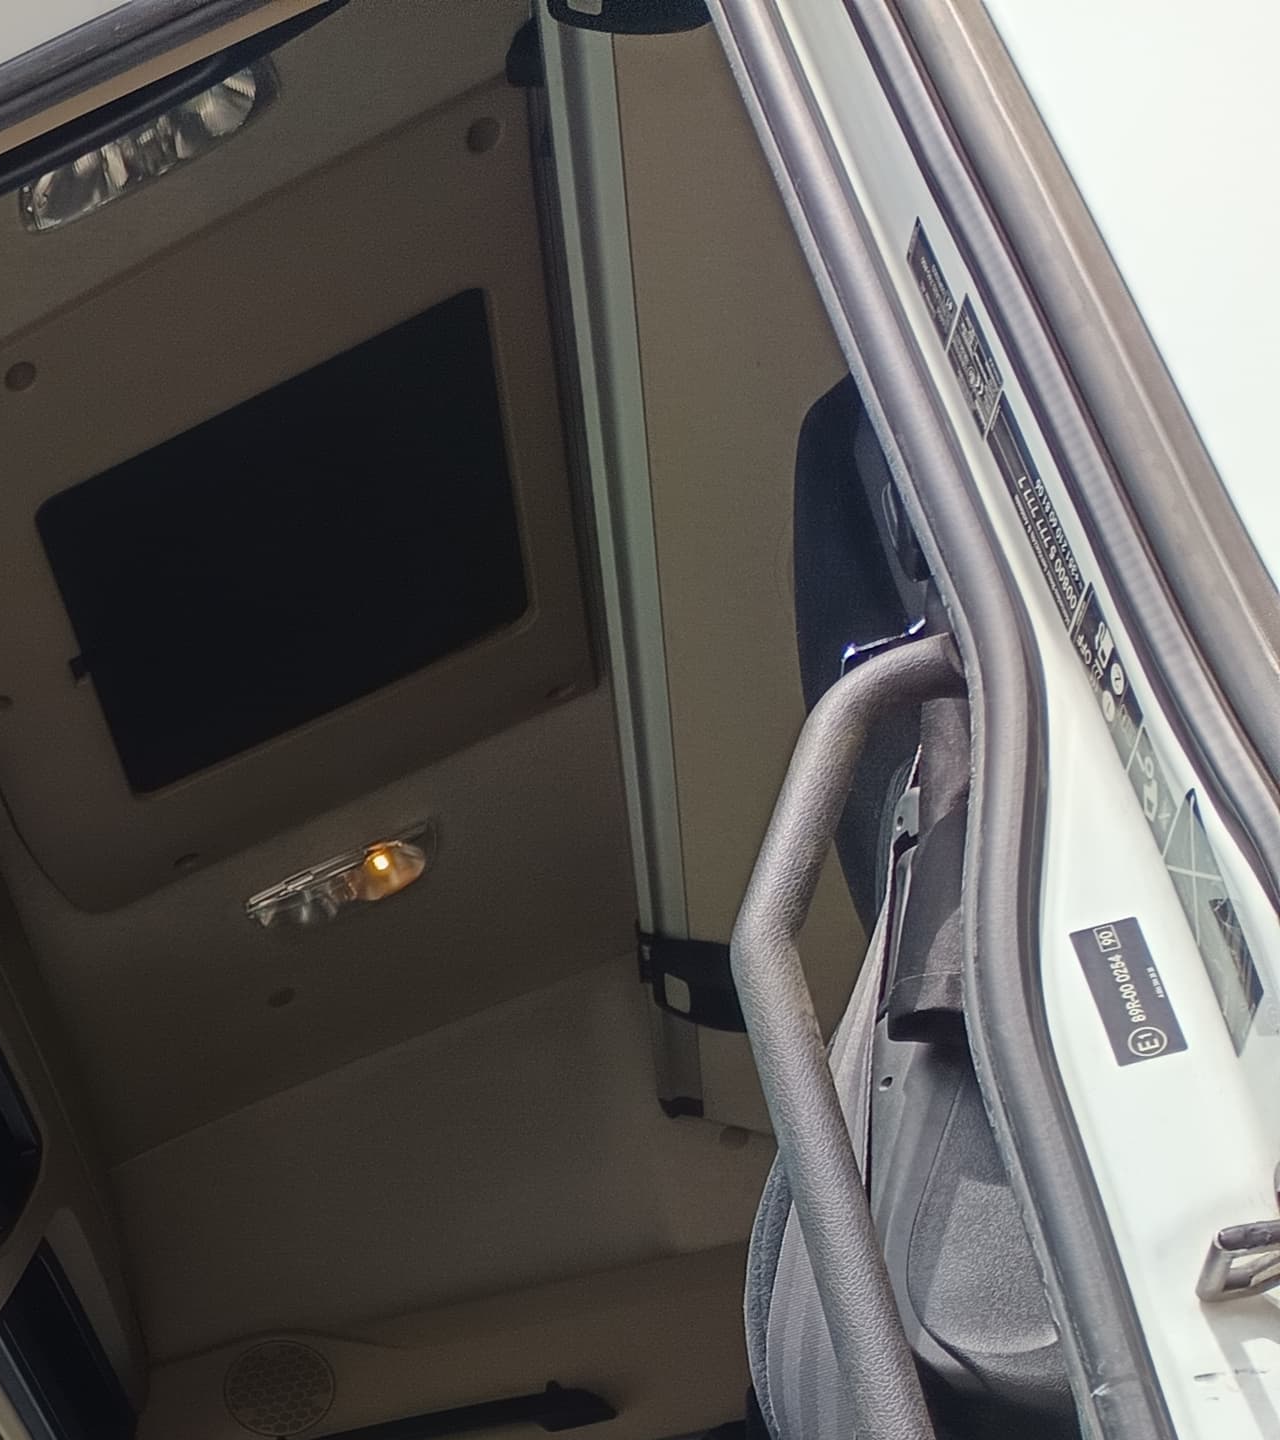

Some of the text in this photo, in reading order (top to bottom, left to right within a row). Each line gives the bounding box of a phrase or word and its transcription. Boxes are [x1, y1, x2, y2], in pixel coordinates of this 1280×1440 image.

[1023, 489, 1037, 519] 777
[1036, 518, 1050, 549] 777
[1076, 633, 1093, 666] OFF
[1118, 983, 1147, 1023] 89R-00
[1136, 1031, 1161, 1052] E1
